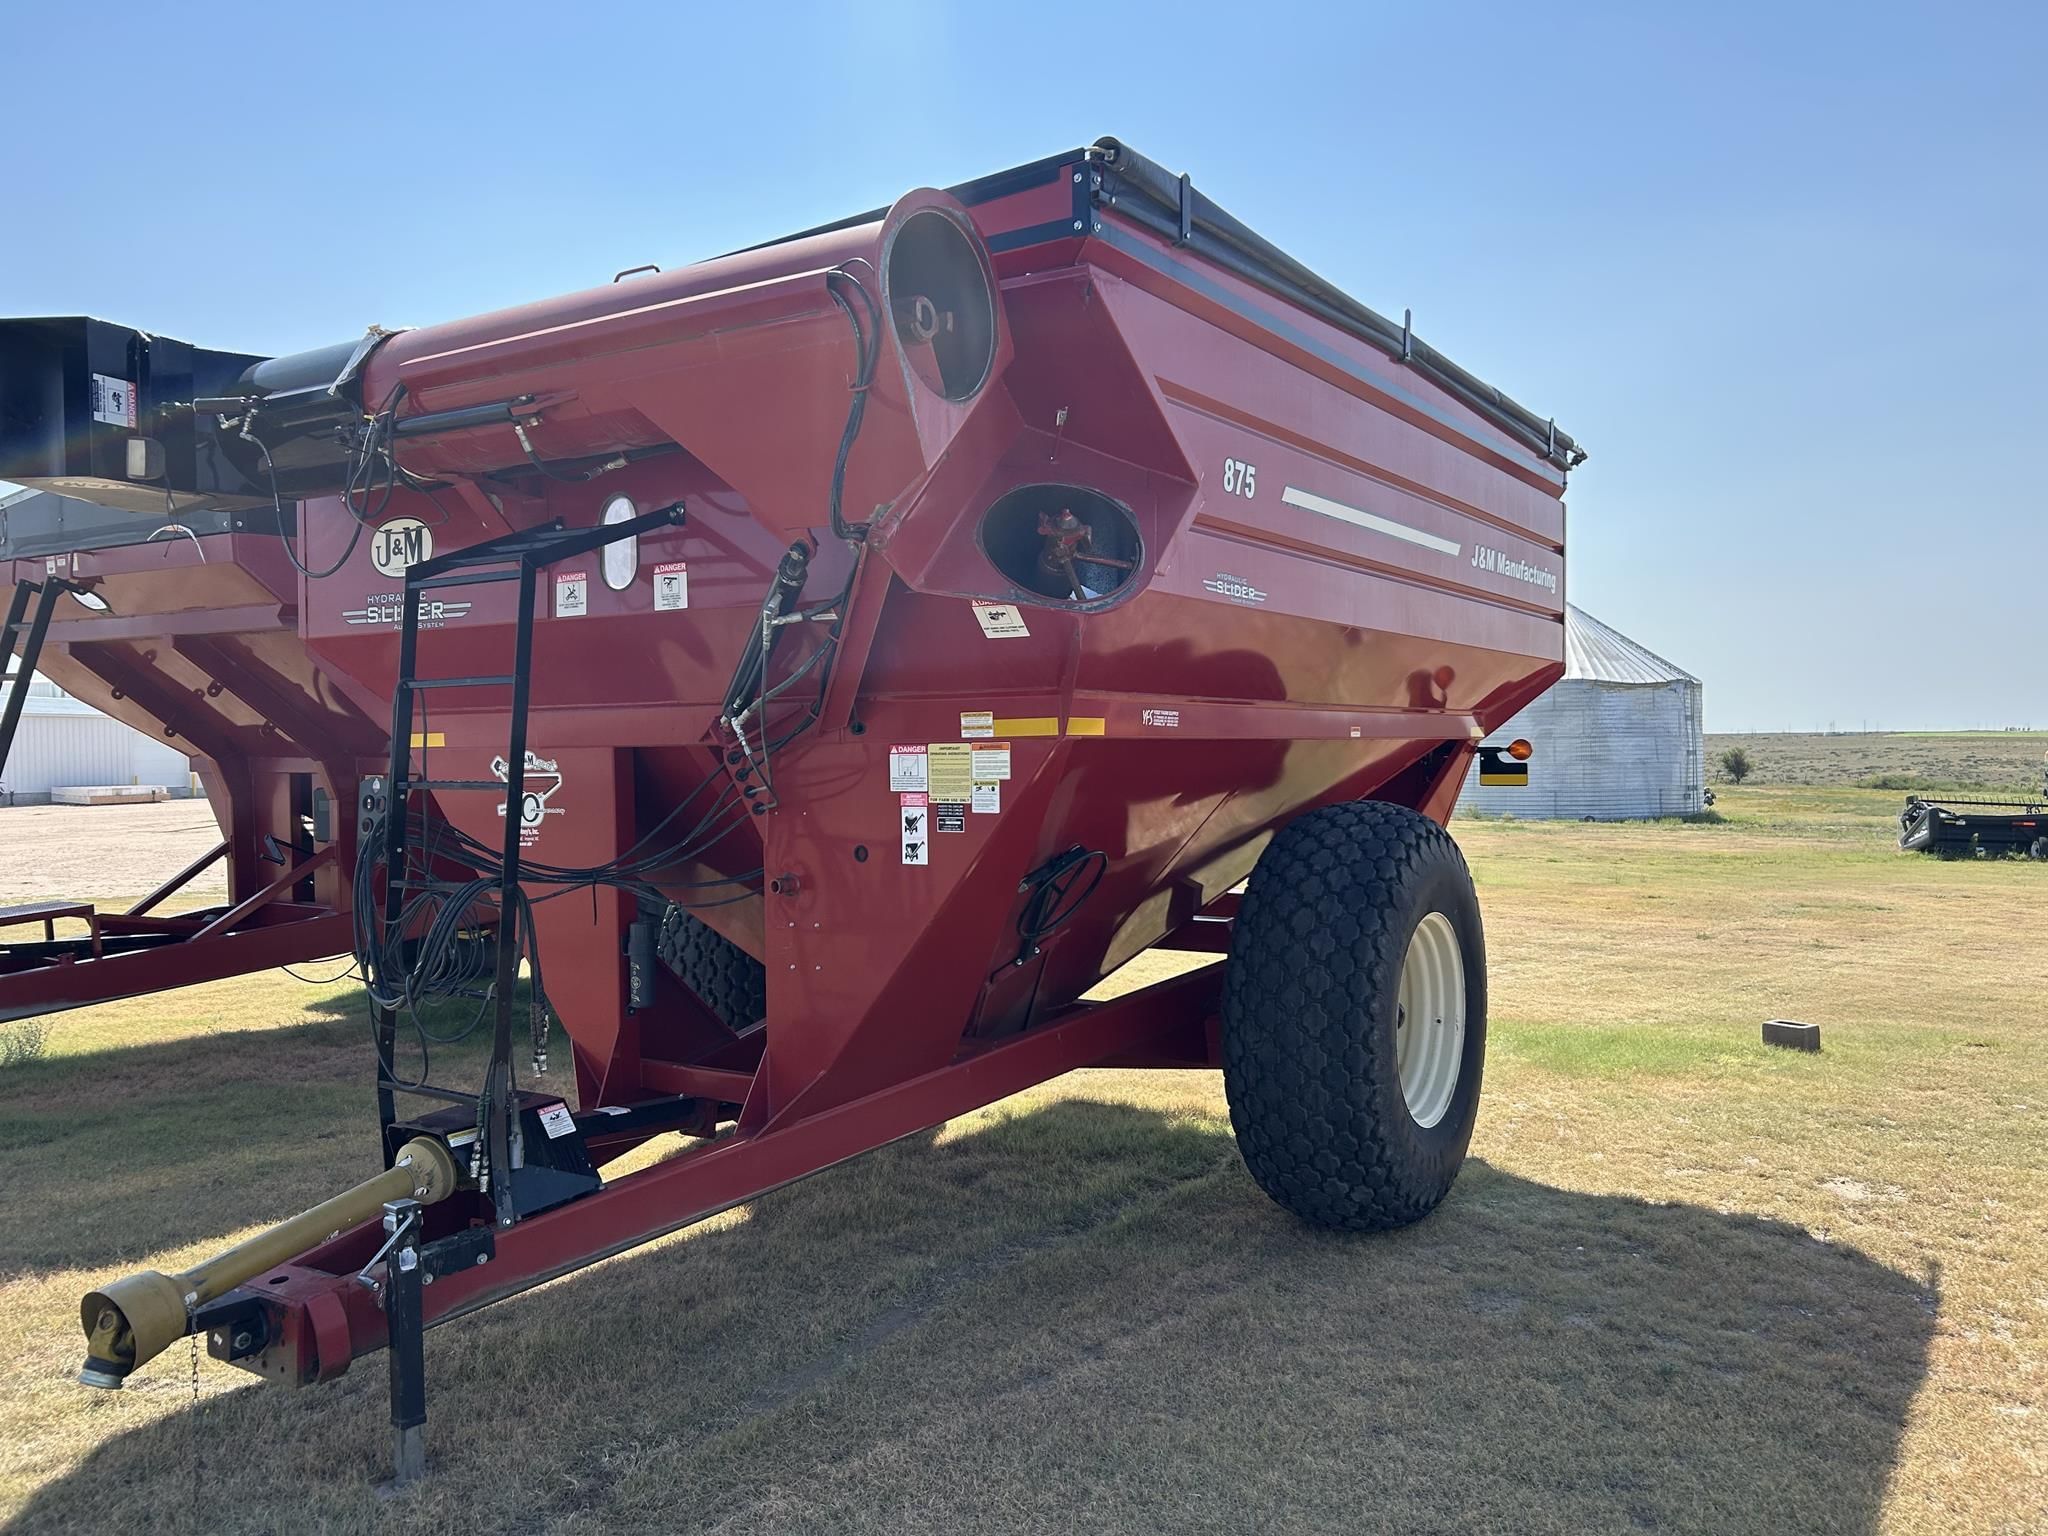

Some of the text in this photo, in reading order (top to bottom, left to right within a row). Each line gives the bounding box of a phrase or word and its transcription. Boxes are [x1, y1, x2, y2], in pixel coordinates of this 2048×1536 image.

[128, 392, 136, 428] DANGER
[1223, 457, 1256, 499] 875
[376, 525, 424, 567] J&M
[562, 573, 587, 582] DANGER
[660, 562, 687, 572] DANGER
[1472, 544, 1557, 594] J&M Manufacturing
[367, 592, 427, 604] HYDRAC
[1216, 581, 1255, 600] SLIDER
[367, 602, 444, 623] SLIER
